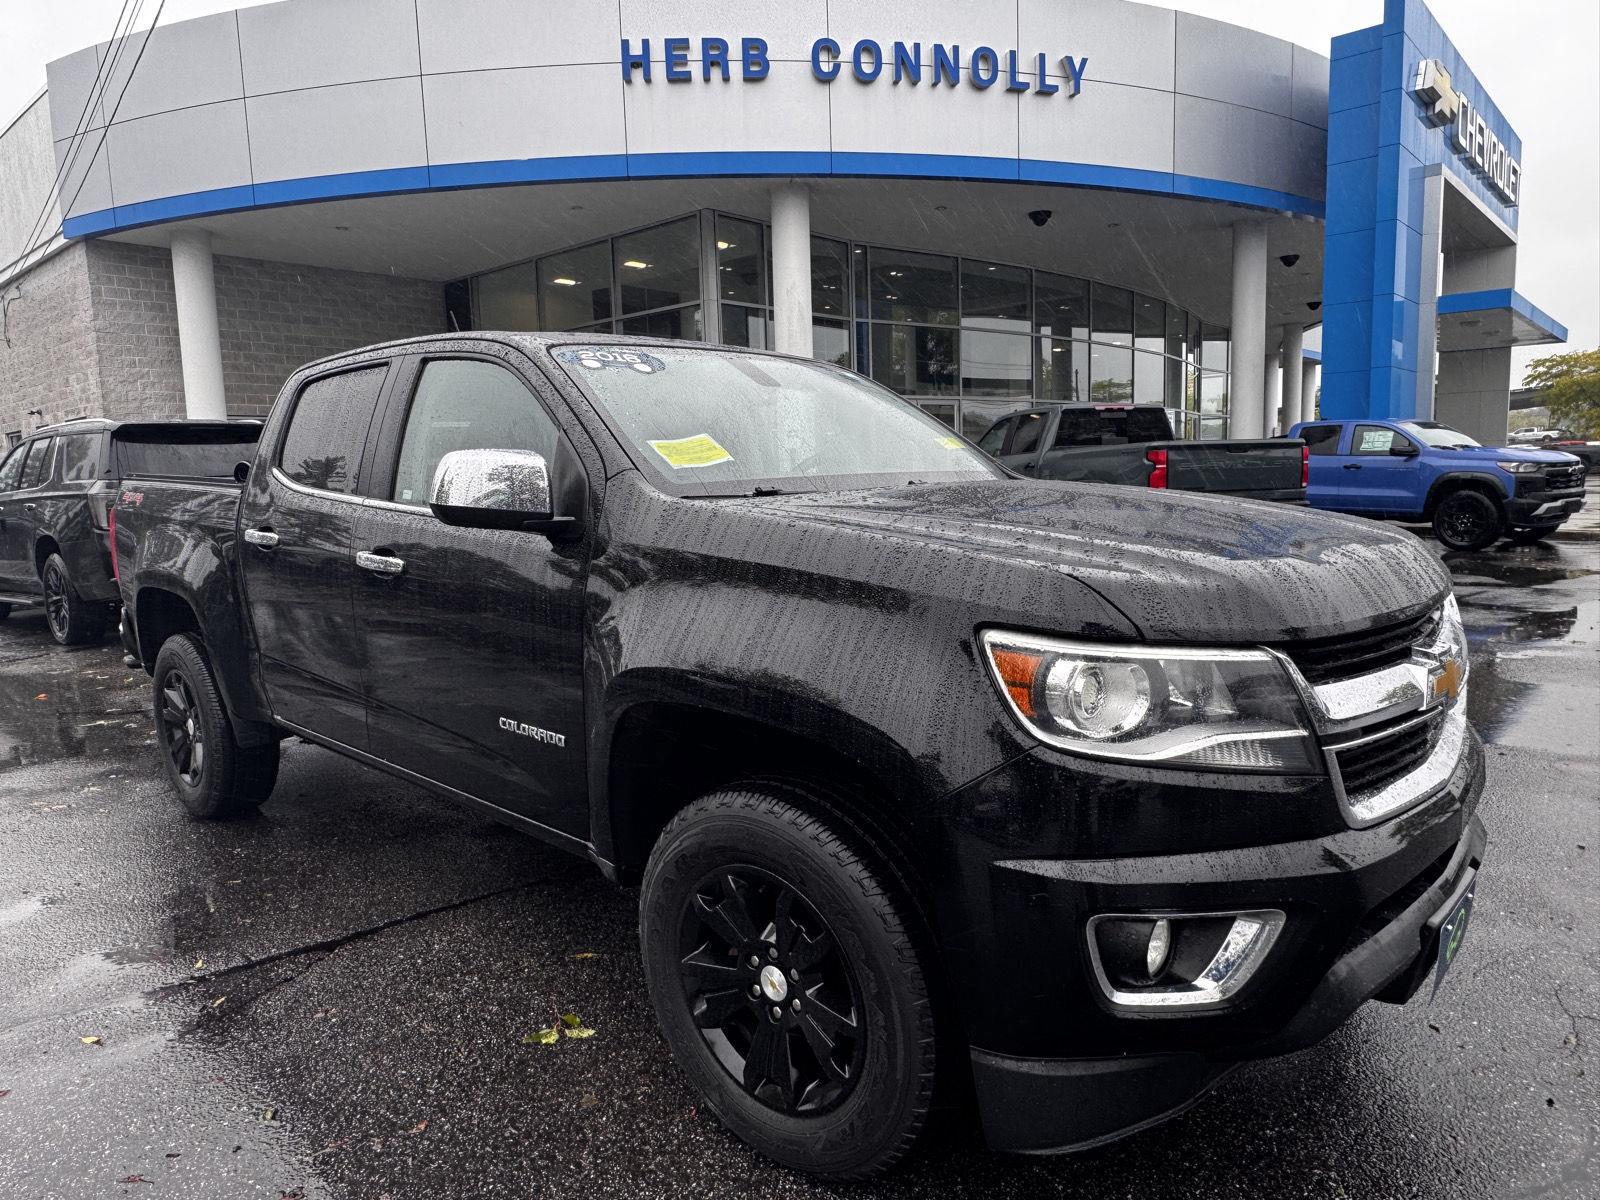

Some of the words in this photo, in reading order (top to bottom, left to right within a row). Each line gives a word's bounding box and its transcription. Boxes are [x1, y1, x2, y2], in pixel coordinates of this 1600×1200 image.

[620, 37, 771, 83] HERB
[811, 37, 1089, 97] CONNOLLY
[1457, 91, 1521, 204] CHEVROLET
[499, 716, 566, 748] COLORADO
